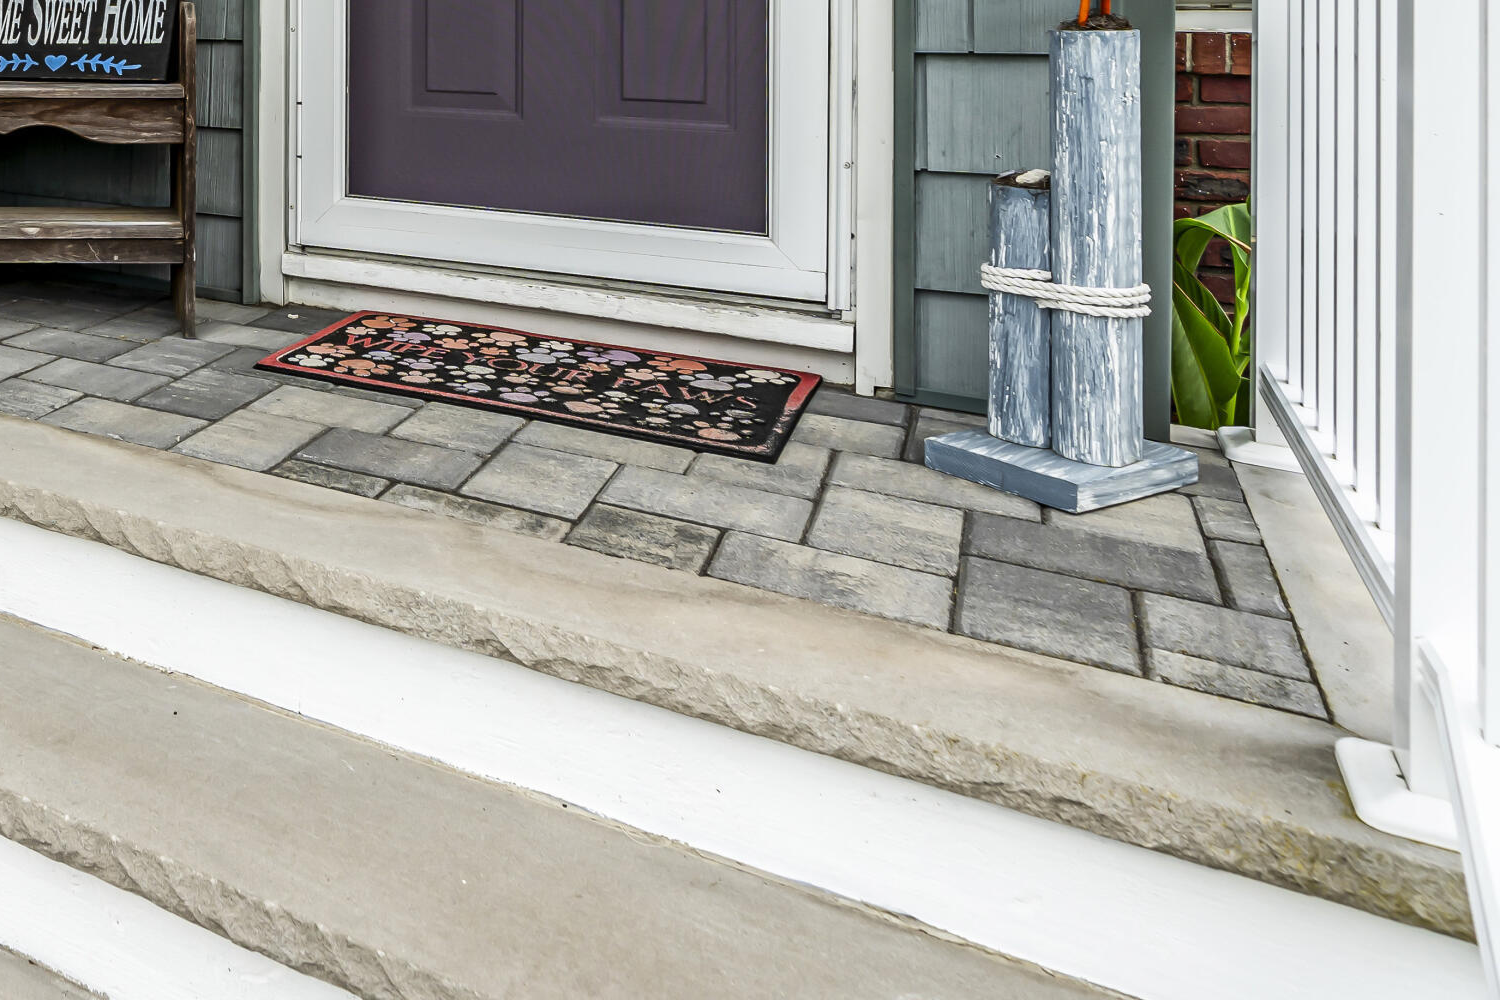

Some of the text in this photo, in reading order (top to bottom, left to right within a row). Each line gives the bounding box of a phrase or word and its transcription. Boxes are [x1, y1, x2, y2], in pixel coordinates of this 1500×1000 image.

[346, 334, 757, 409] WIPE YOUR PAWS
